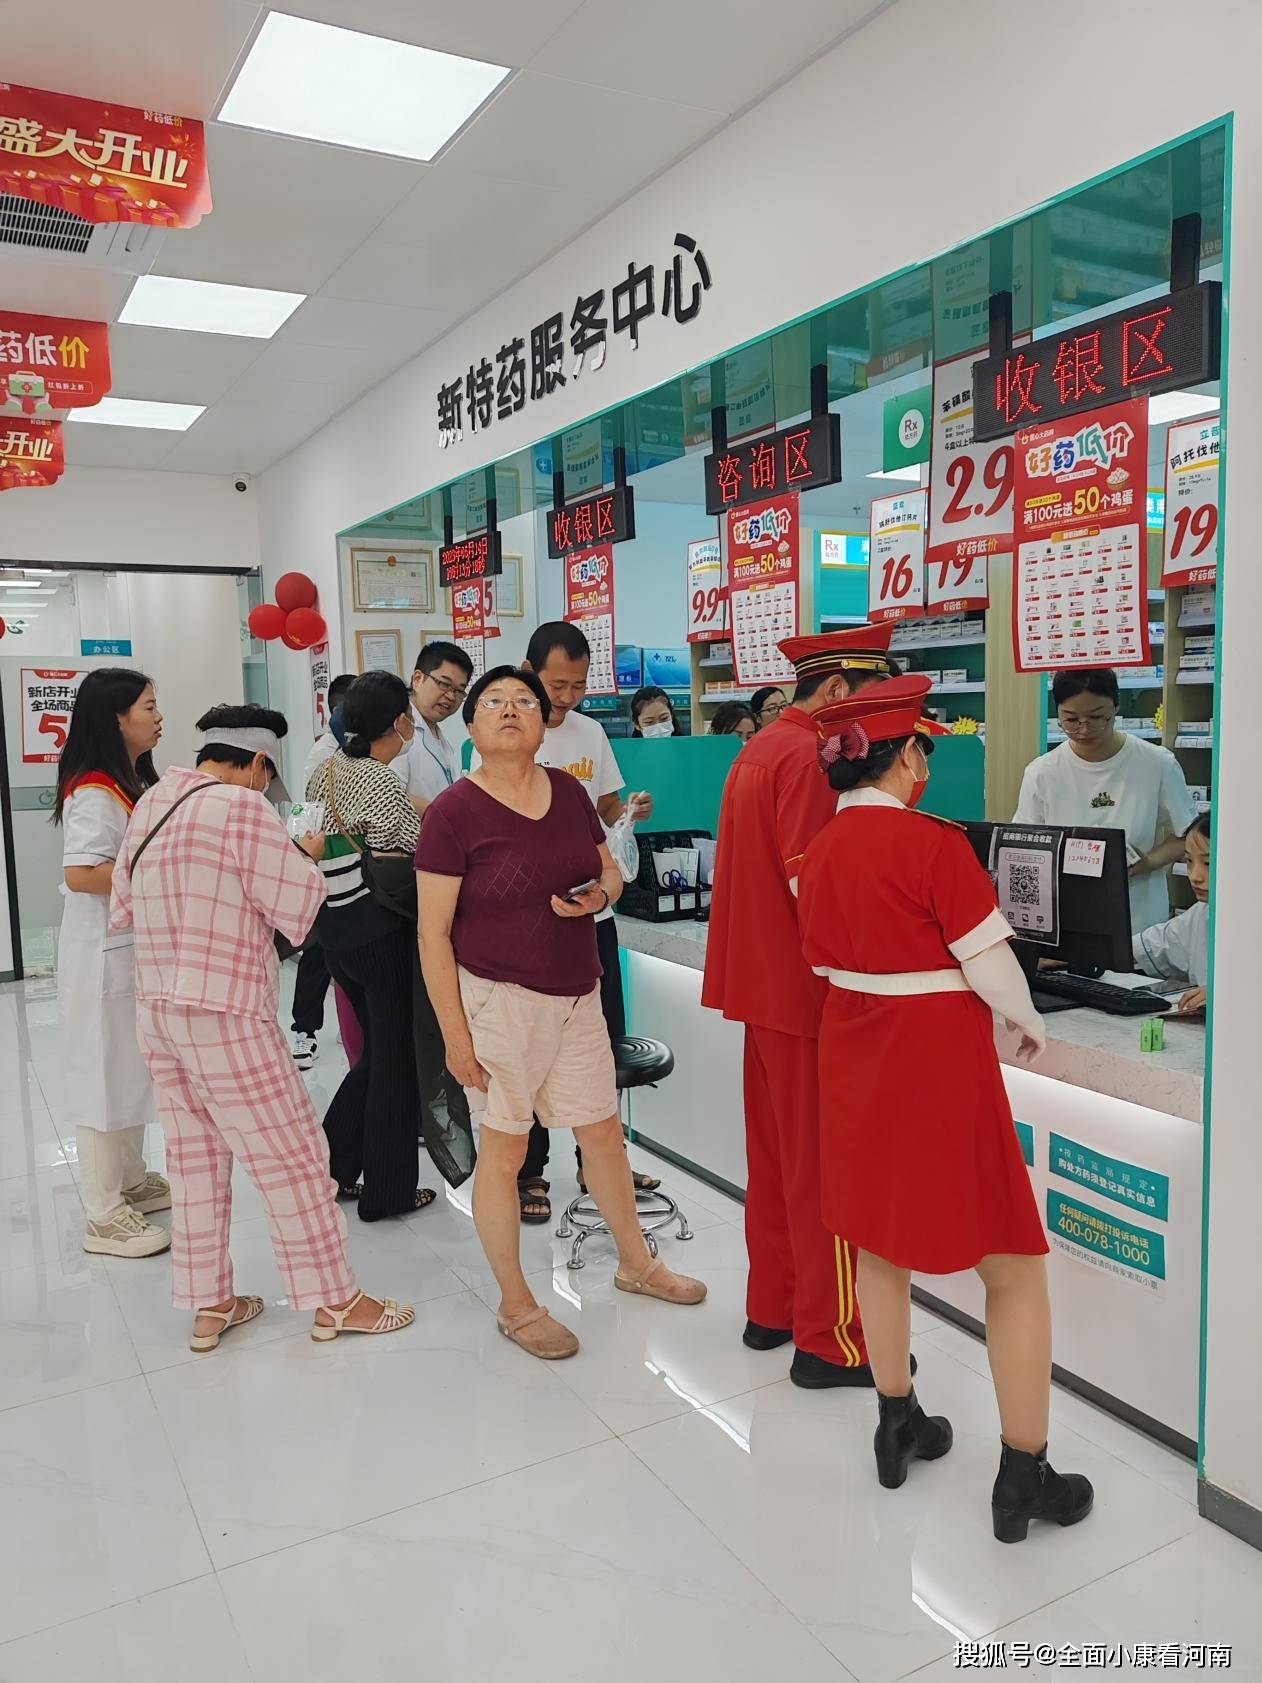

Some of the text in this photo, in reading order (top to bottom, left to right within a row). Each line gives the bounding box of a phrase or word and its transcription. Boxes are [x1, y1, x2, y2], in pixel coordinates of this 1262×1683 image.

[0, 116, 188, 189] 盛大开业
[0, 330, 90, 369] 药低价
[437, 232, 712, 449] 新特药服务中心
[995, 306, 1174, 423] 收银区
[904, 419, 918, 433] Rx
[0, 431, 54, 462] 开业
[718, 429, 813, 503] 咨询区
[1026, 421, 1134, 478] 好药低价
[554, 496, 615, 550] 收银区
[1023, 486, 1134, 524] 满100元送50个鸡蛋
[734, 507, 791, 544] 好药低价
[825, 539, 839, 551] Rx
[956, 538, 998, 556] 好药低价
[880, 554, 913, 601] 16
[692, 587, 719, 624] 9.9
[93, 645, 120, 654] 办公区
[39, 713, 68, 748] 5
[1058, 1157, 1156, 1208] 购处方药须登记真实信息
[1058, 1217, 1150, 1266] 400-078-1000
